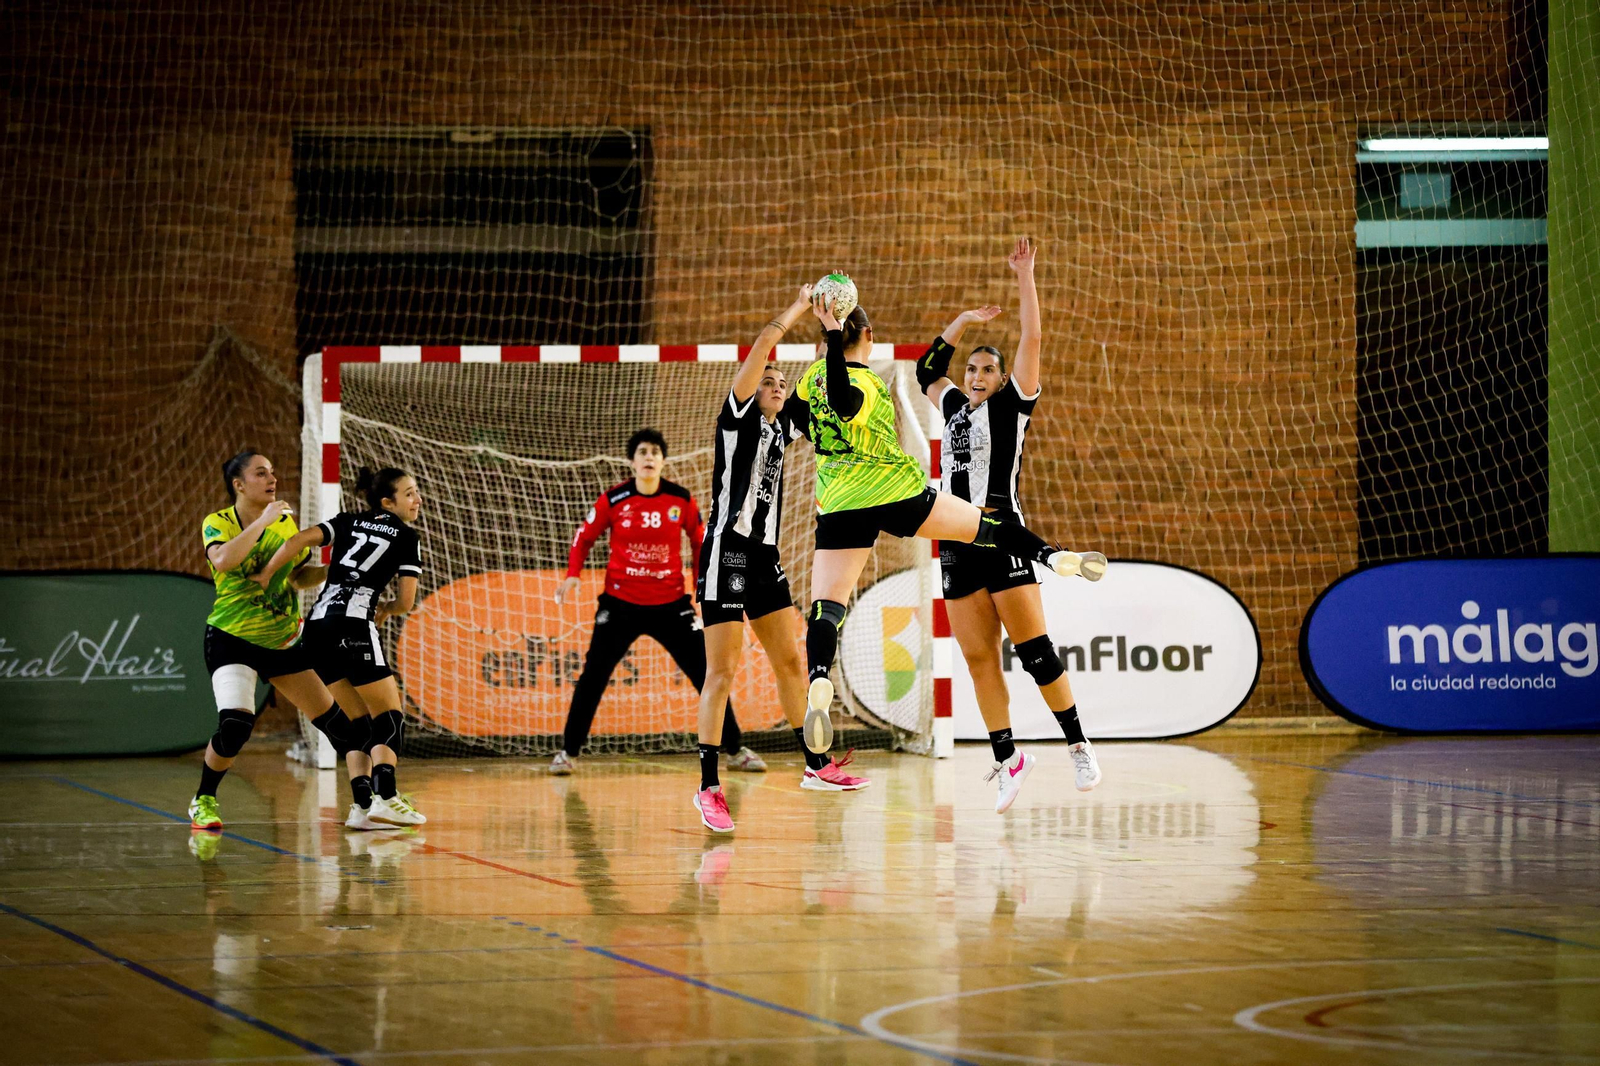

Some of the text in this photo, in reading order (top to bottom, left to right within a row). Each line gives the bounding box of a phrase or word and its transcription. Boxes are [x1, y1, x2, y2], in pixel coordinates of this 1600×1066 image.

[359, 520, 400, 538] MEDEIROS
[640, 511, 662, 529] 38
[339, 530, 391, 573] 27
[0, 613, 184, 685] ual Hair
[1390, 674, 1556, 691] la ciudad redonda
